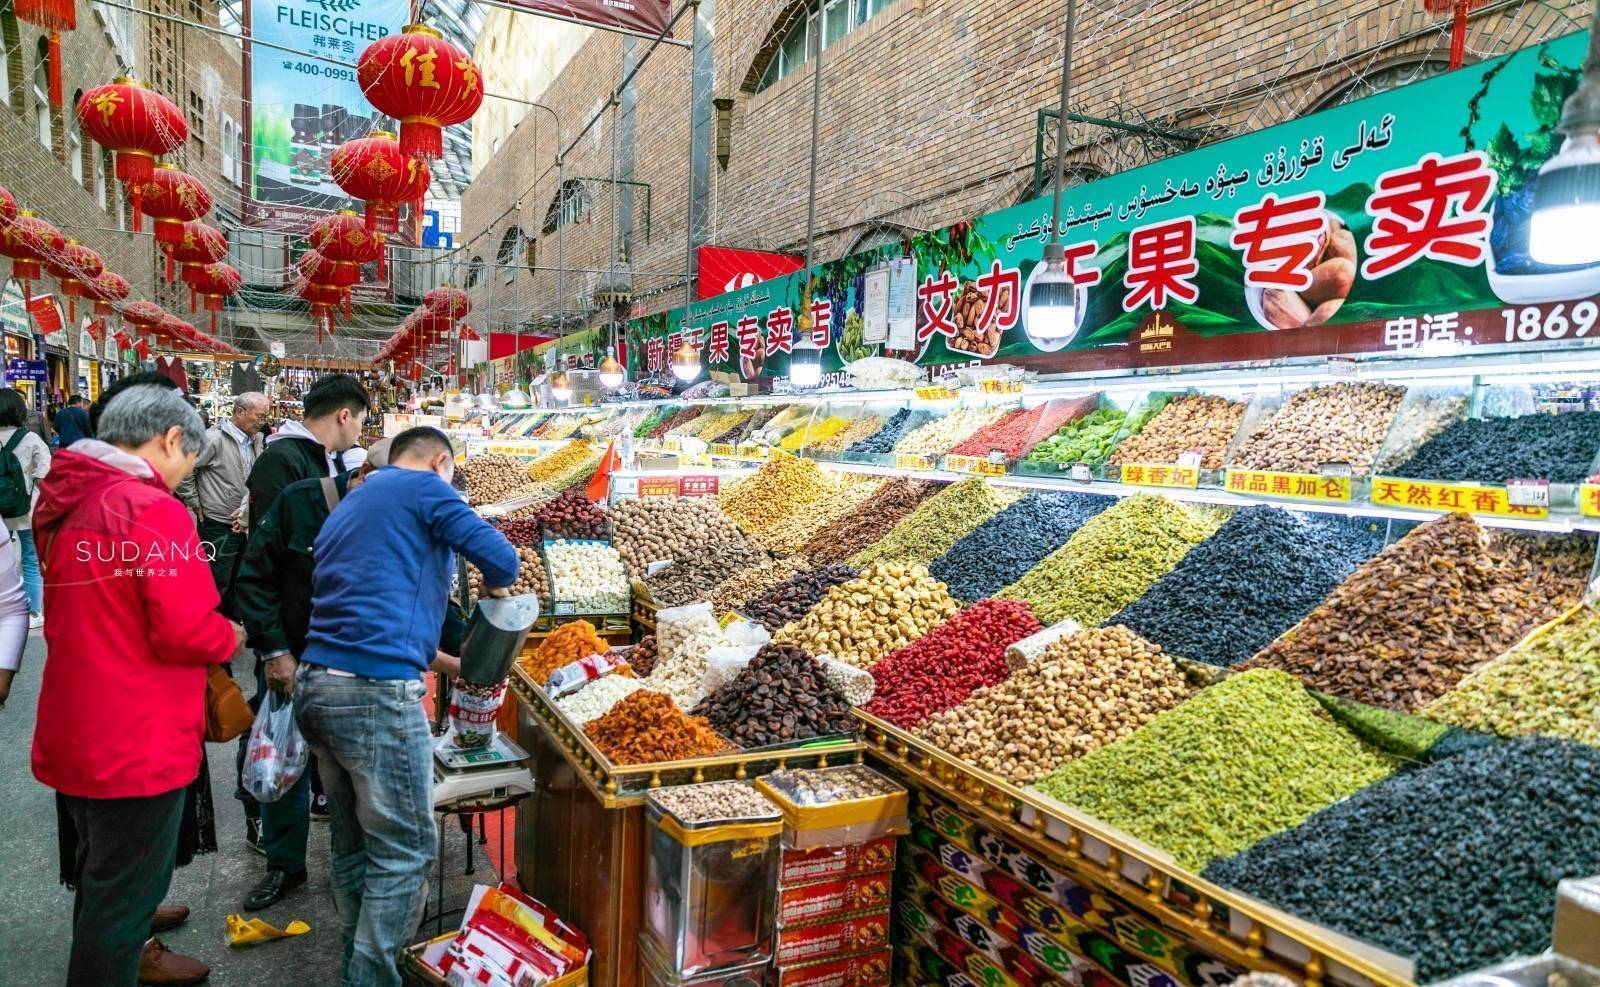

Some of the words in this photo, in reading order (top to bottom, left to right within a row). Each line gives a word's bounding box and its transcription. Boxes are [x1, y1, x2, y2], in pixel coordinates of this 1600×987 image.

[277, 5, 389, 41] FLEISCHER
[1502, 301, 1599, 342] 1869
[1126, 466, 1194, 486] 绿香妃
[1230, 472, 1343, 499] 精品黑加仑
[1379, 482, 1541, 515] 天然红香
